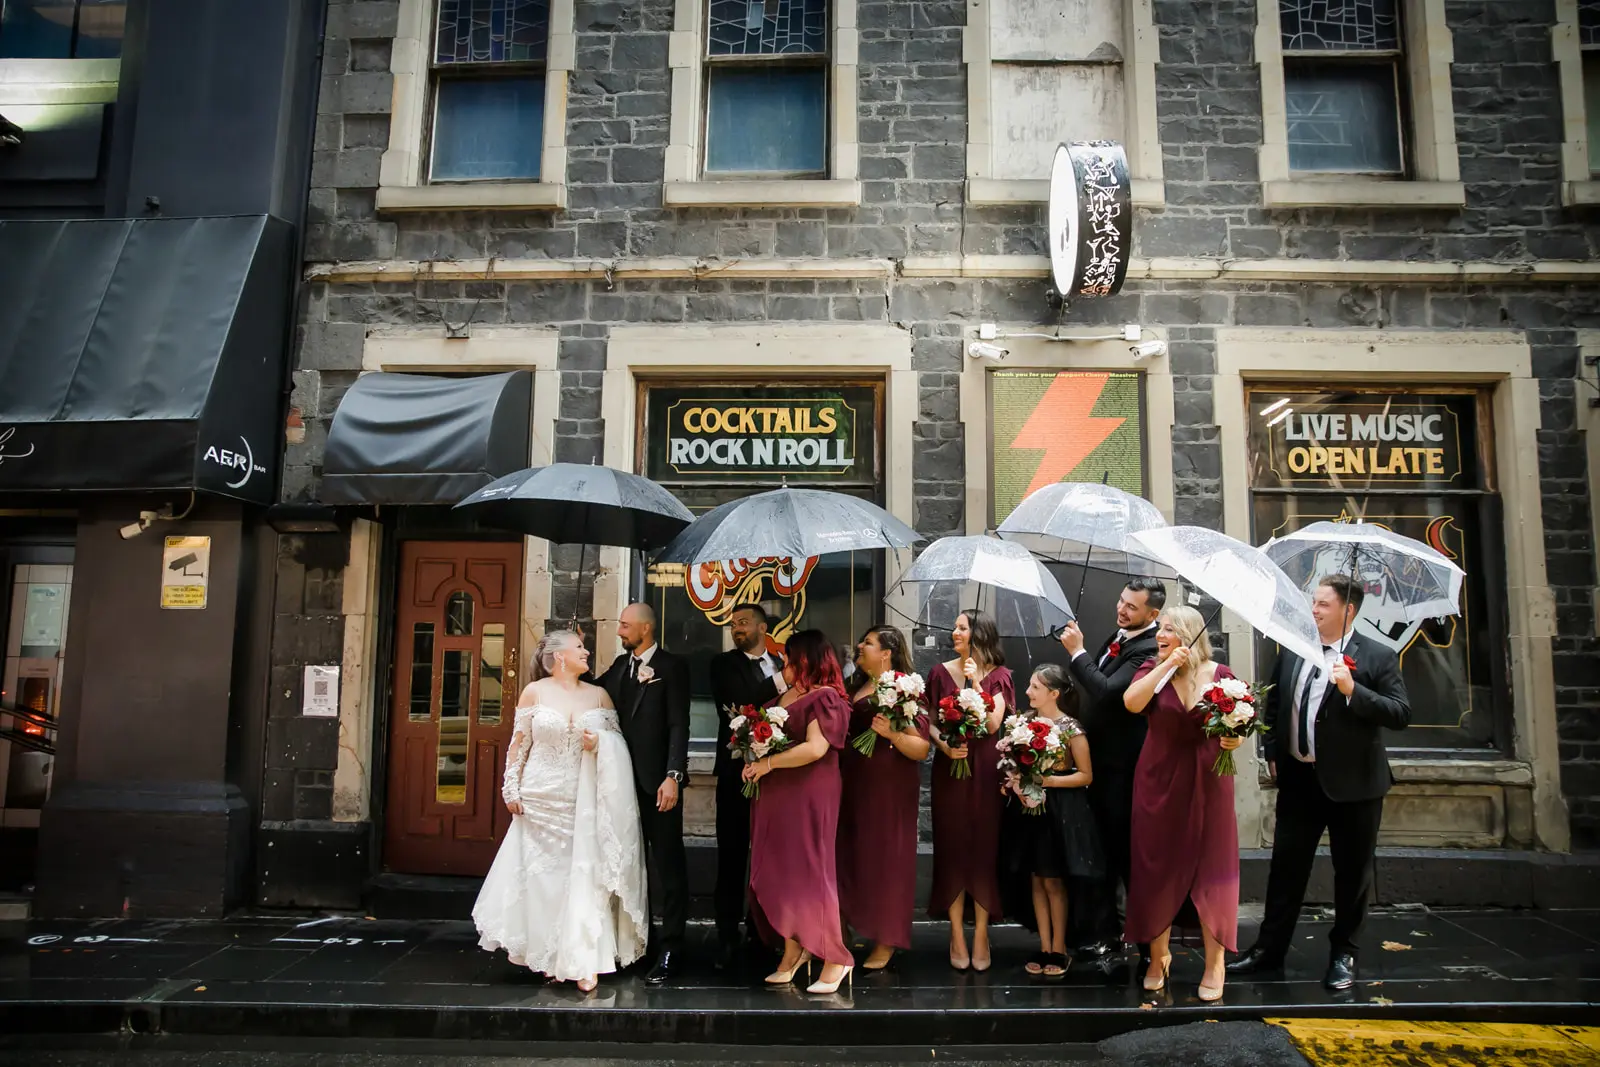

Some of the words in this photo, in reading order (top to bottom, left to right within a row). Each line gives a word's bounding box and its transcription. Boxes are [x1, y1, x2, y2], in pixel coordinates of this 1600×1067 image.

[683, 407, 837, 434] COCKTAILS
[1285, 414, 1347, 441] LIVE
[1350, 413, 1444, 442] MUSIC
[670, 438, 748, 466] ROCK
[751, 438, 775, 466] N
[778, 438, 855, 466] ROLL
[1287, 447, 1366, 474] OPEN
[1369, 447, 1445, 474] LATE
